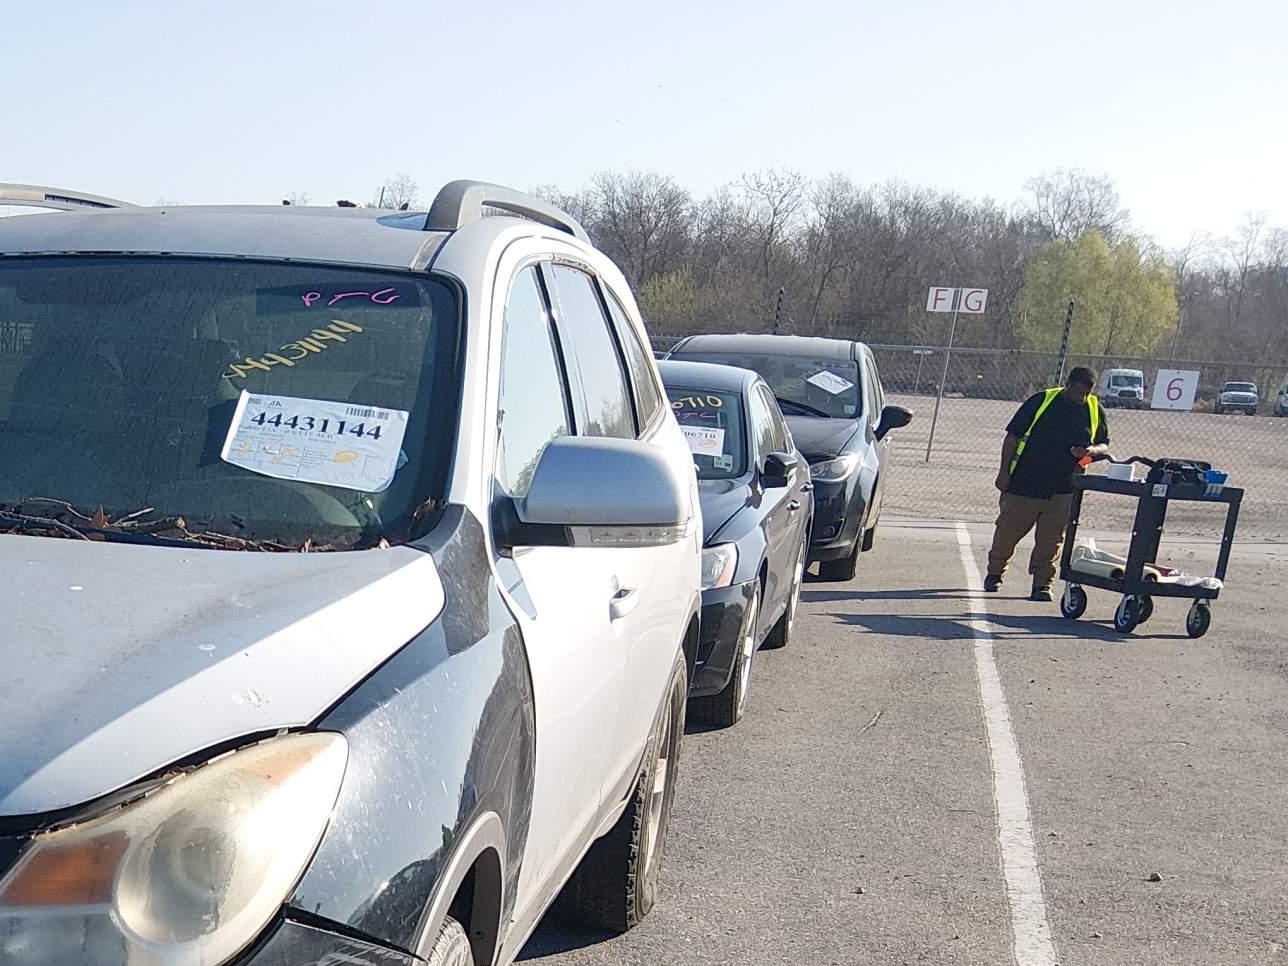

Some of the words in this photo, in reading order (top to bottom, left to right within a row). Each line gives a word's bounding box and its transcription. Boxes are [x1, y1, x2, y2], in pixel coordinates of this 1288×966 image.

[933, 288, 948, 310] F
[964, 290, 984, 312] G
[1166, 377, 1184, 402] 6
[250, 411, 382, 440] 44431144
